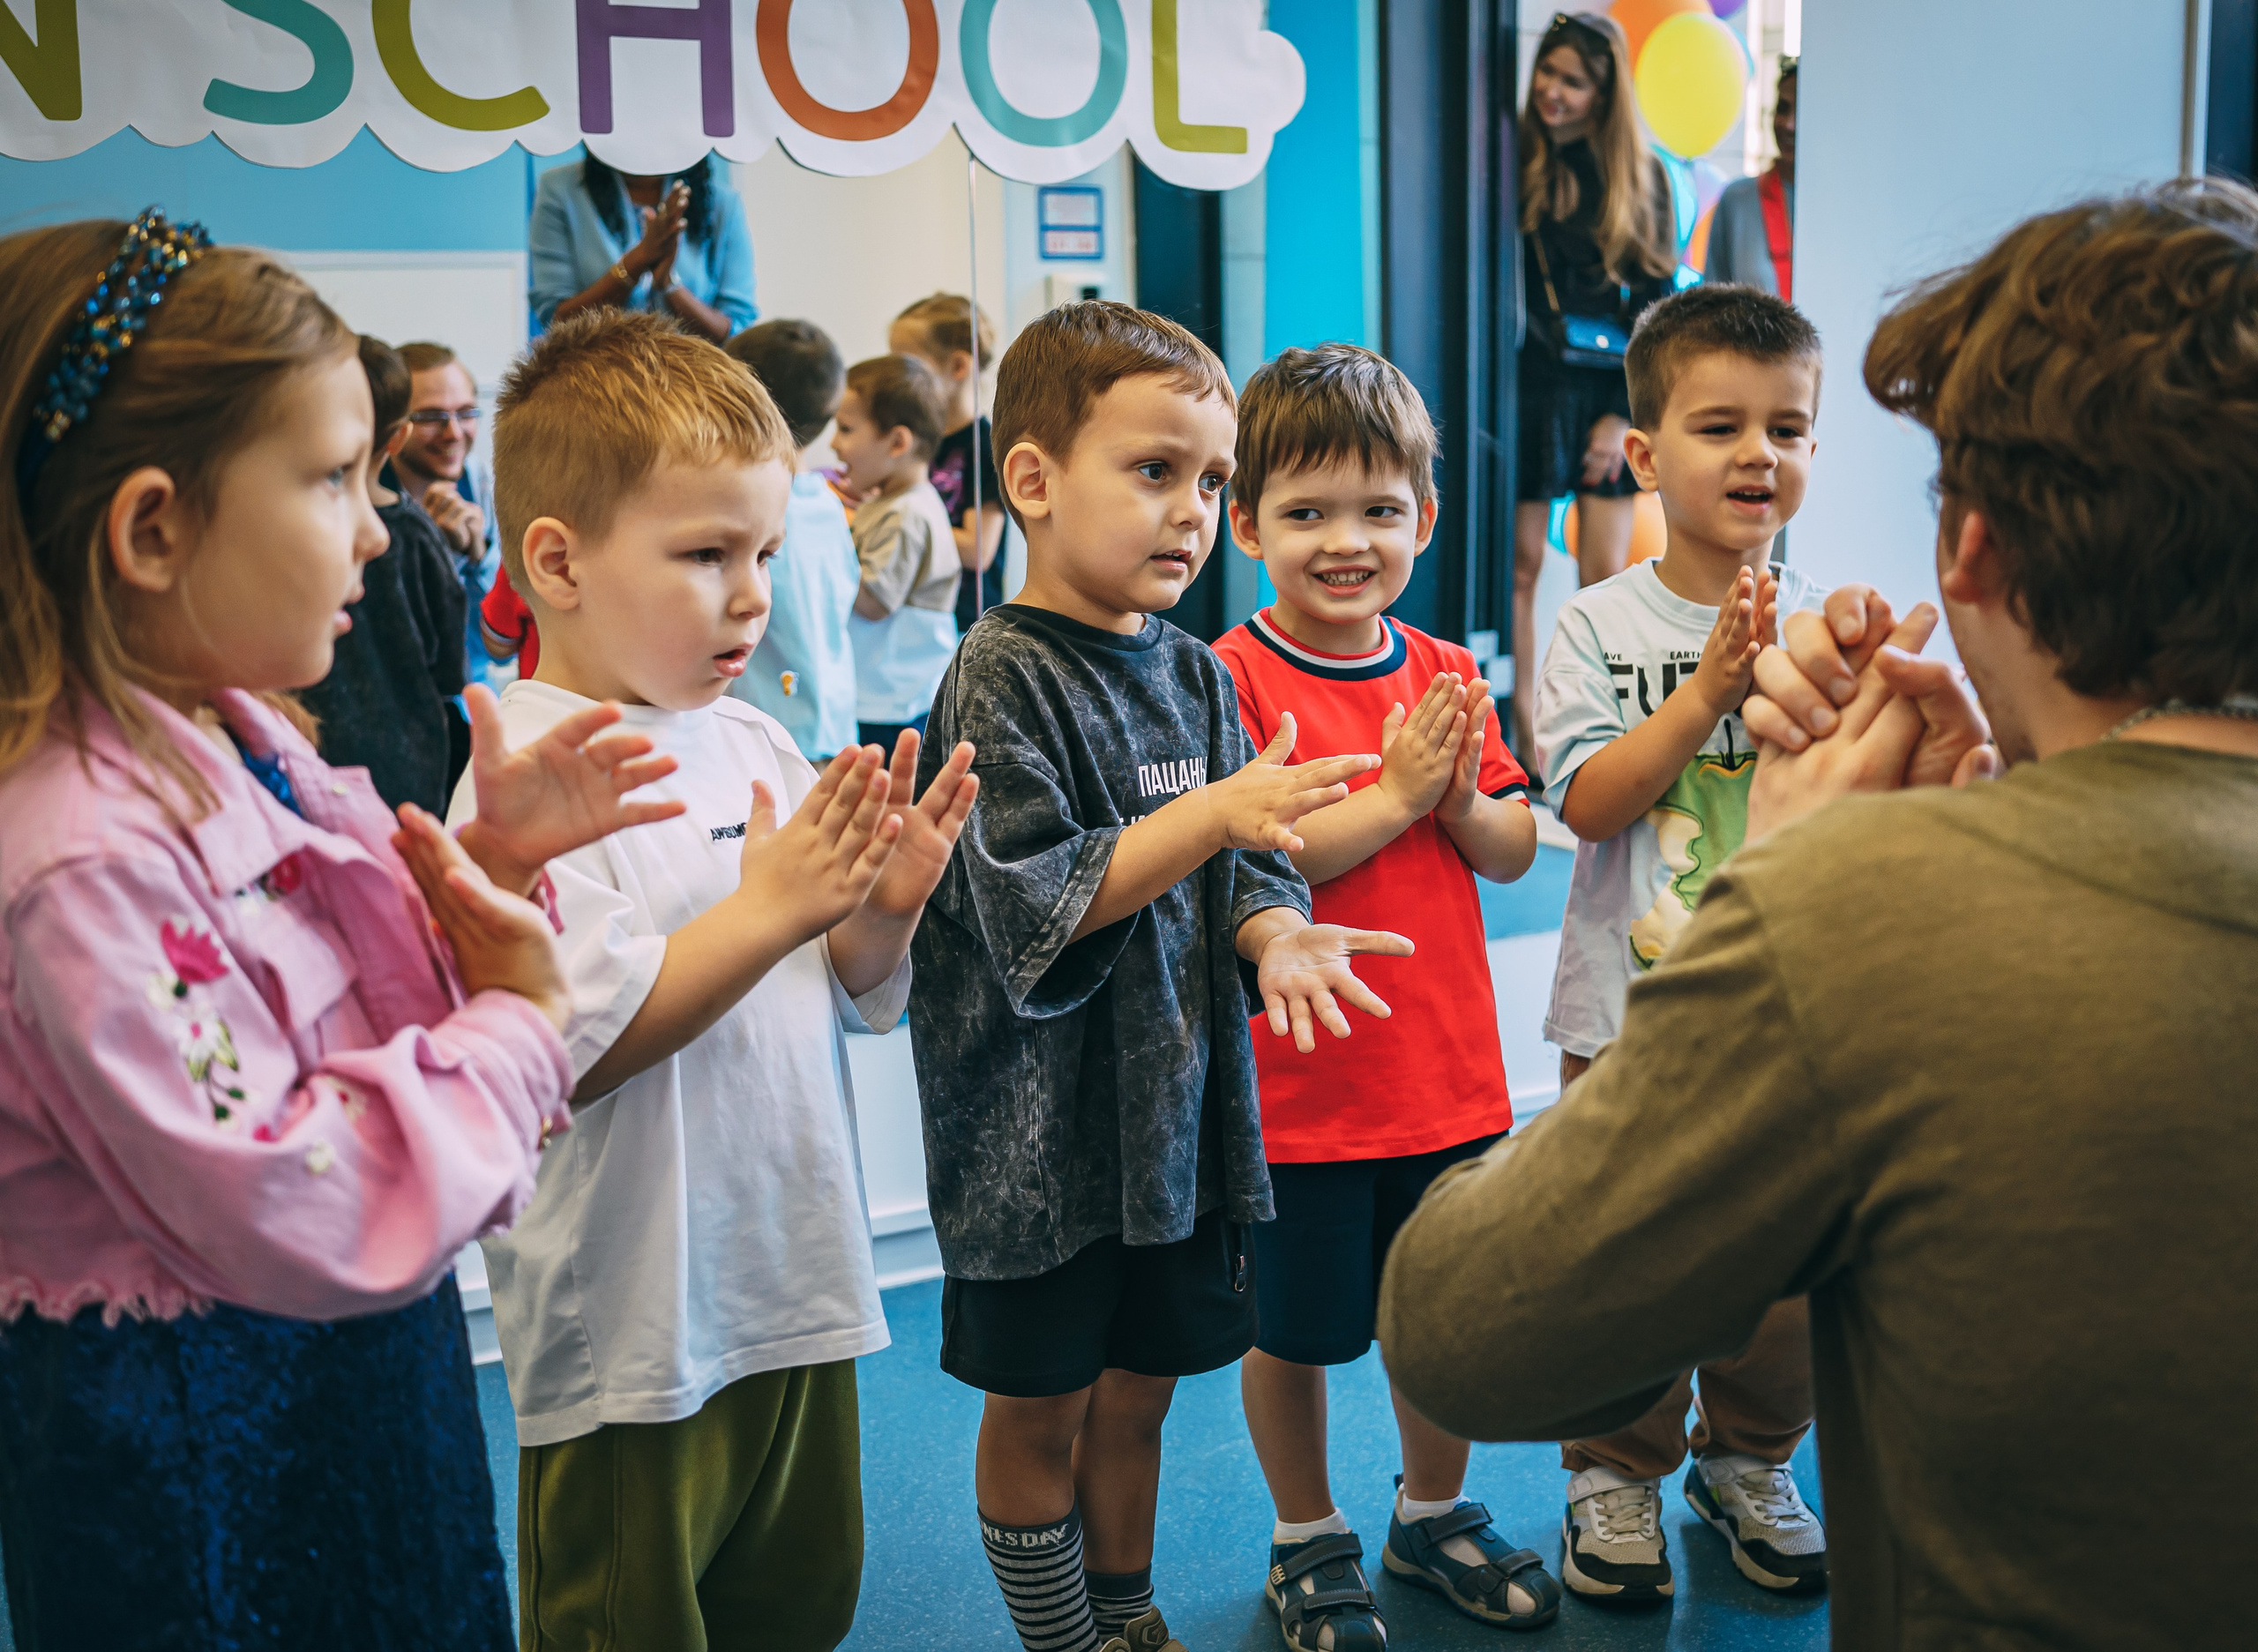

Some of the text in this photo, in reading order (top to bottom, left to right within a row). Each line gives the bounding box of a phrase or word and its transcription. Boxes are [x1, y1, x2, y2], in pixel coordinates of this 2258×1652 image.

[203, 0, 1247, 154] SCHOOL
[1604, 652, 1623, 662] AVE
[1138, 756, 1208, 797] ПАЦАНЫ
[979, 1521, 1069, 1549] NESDAY
